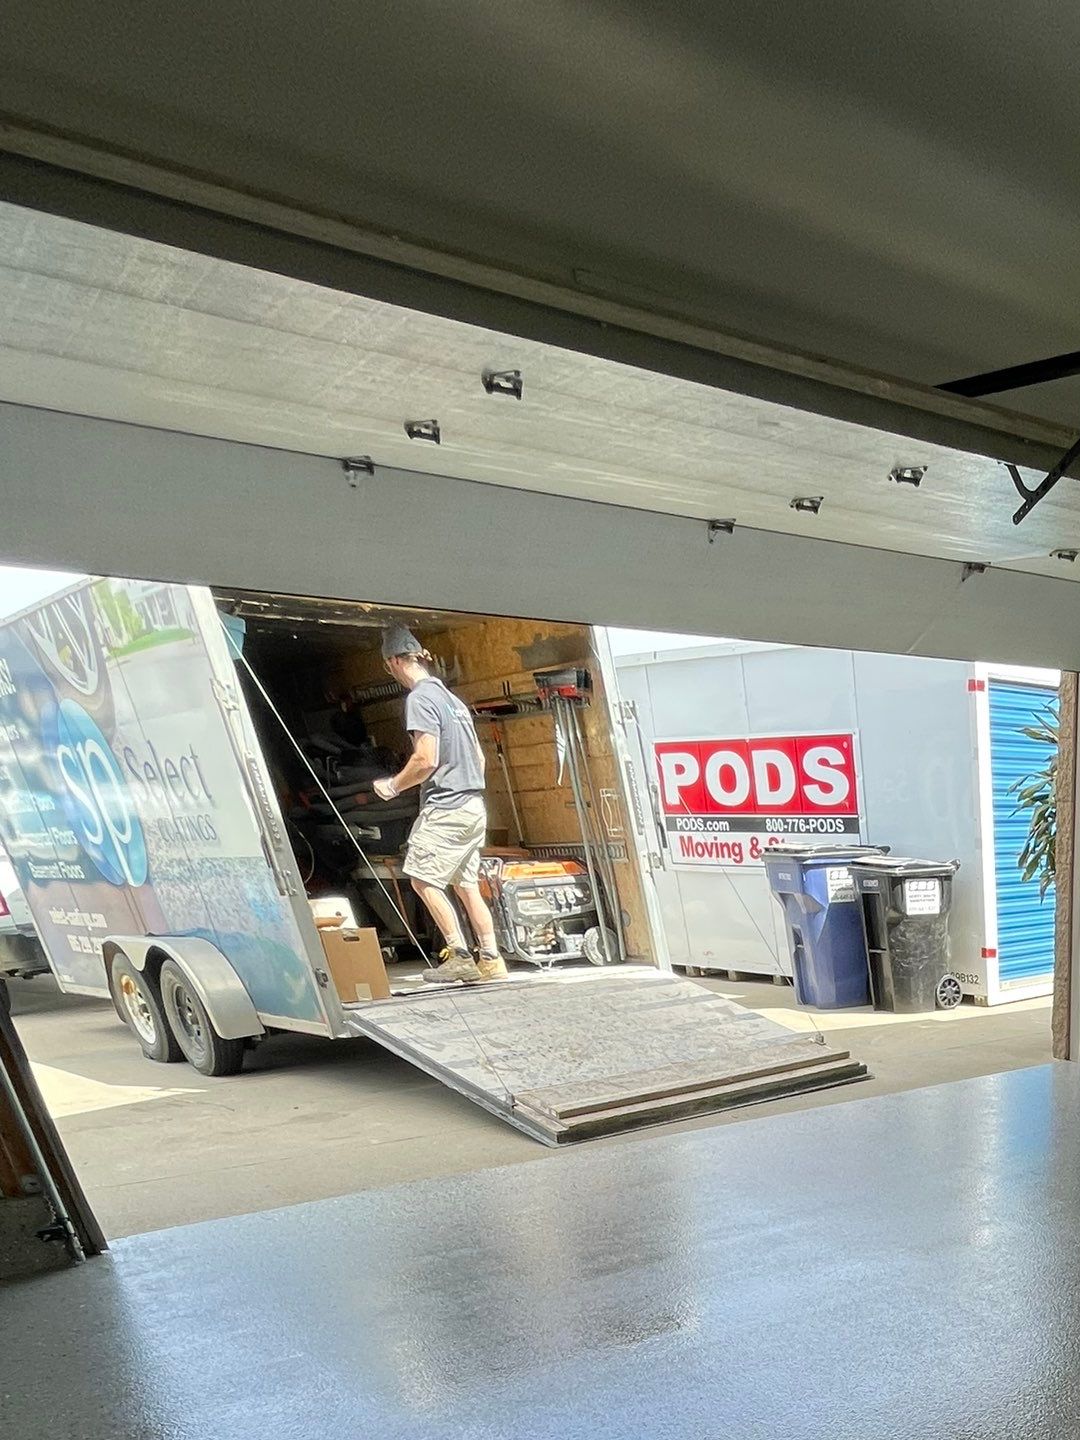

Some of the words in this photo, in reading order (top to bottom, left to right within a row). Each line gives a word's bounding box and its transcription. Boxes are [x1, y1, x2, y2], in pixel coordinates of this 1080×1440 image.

[123, 739, 213, 800] Select
[659, 746, 850, 806] PODS
[157, 814, 218, 842] COATINGS
[676, 818, 730, 832] PODS.com
[765, 818, 845, 833] 800-776-PODS
[679, 835, 743, 864] Moving
[750, 836, 764, 860] &
